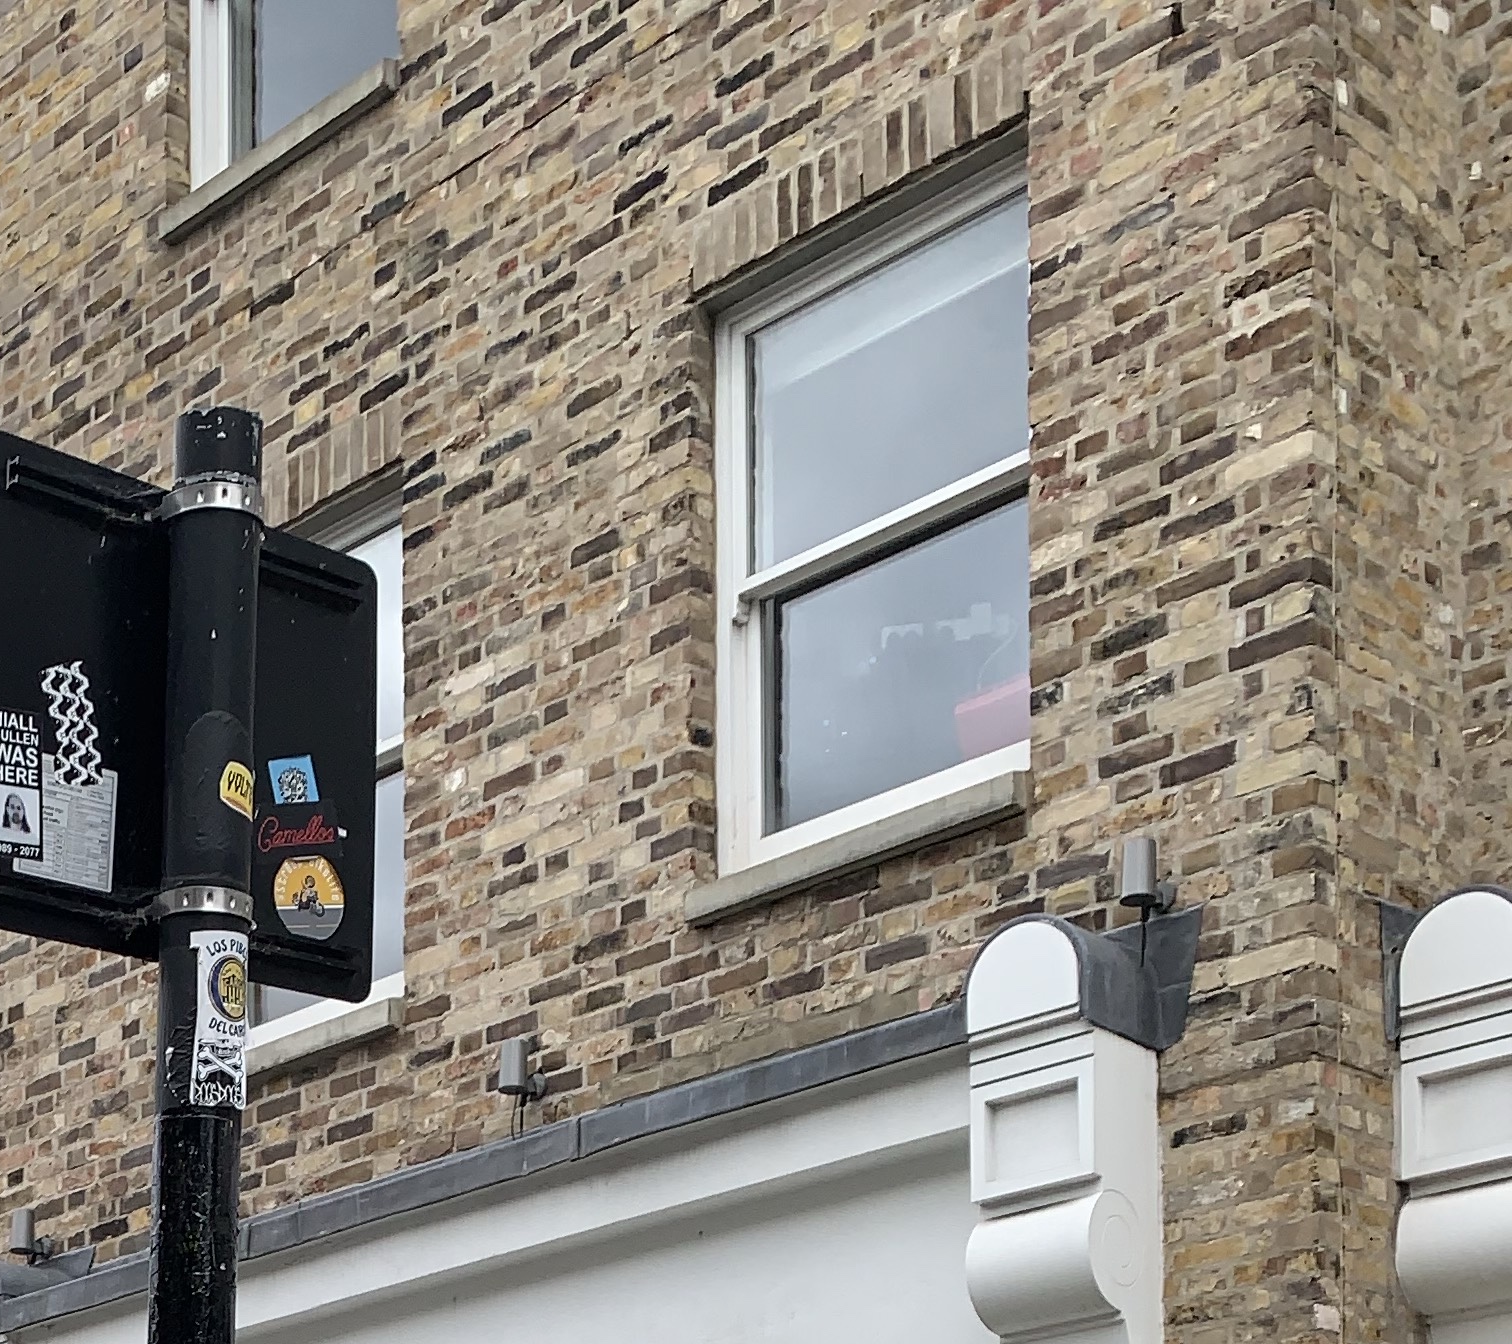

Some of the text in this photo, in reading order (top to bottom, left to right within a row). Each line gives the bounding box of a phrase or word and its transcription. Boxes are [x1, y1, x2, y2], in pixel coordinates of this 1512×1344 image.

[20, 845, 41, 858] 2077
[206, 939, 227, 957] LOS
[209, 1017, 228, 1035] DEL
